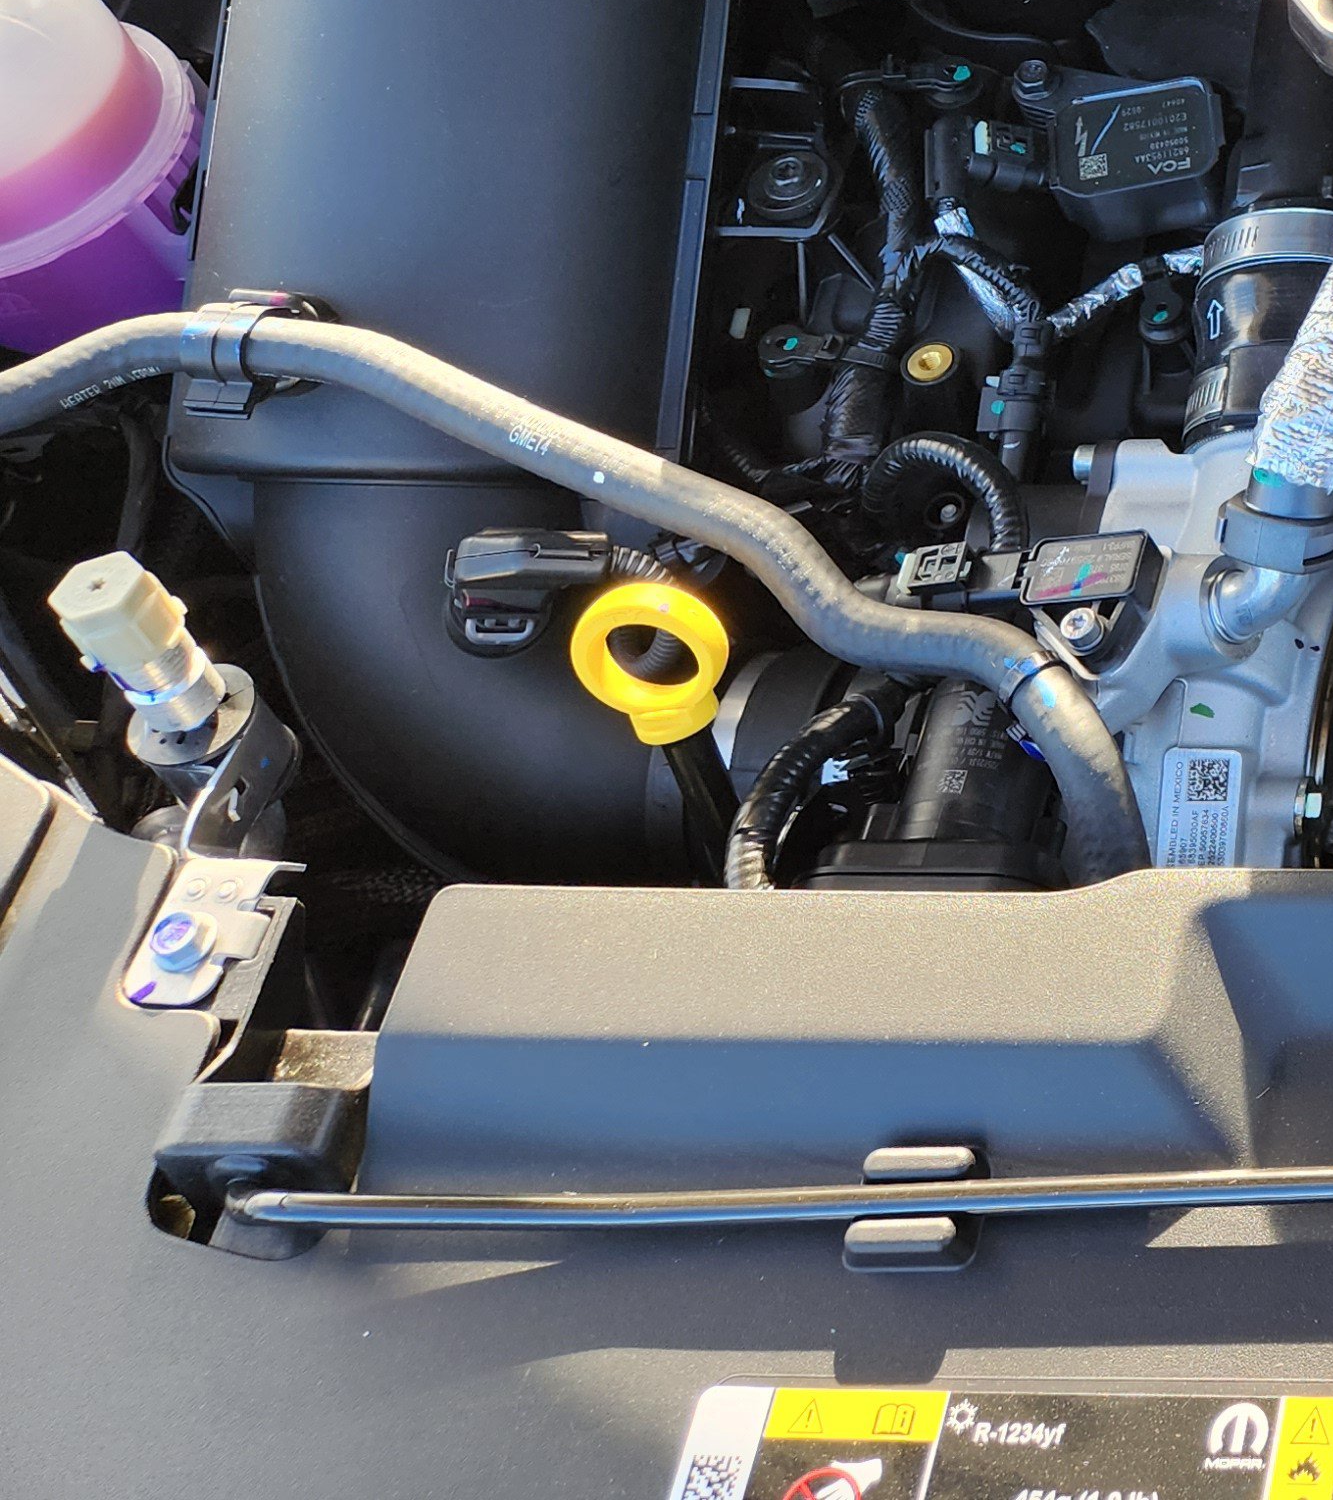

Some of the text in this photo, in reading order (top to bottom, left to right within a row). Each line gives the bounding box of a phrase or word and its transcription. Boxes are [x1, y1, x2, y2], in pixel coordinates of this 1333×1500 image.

[1147, 156, 1190, 174] FCA
[1172, 761, 1183, 802] MEXICO
[1171, 806, 1179, 816] IN
[973, 1422, 1066, 1448] R-1234yf
